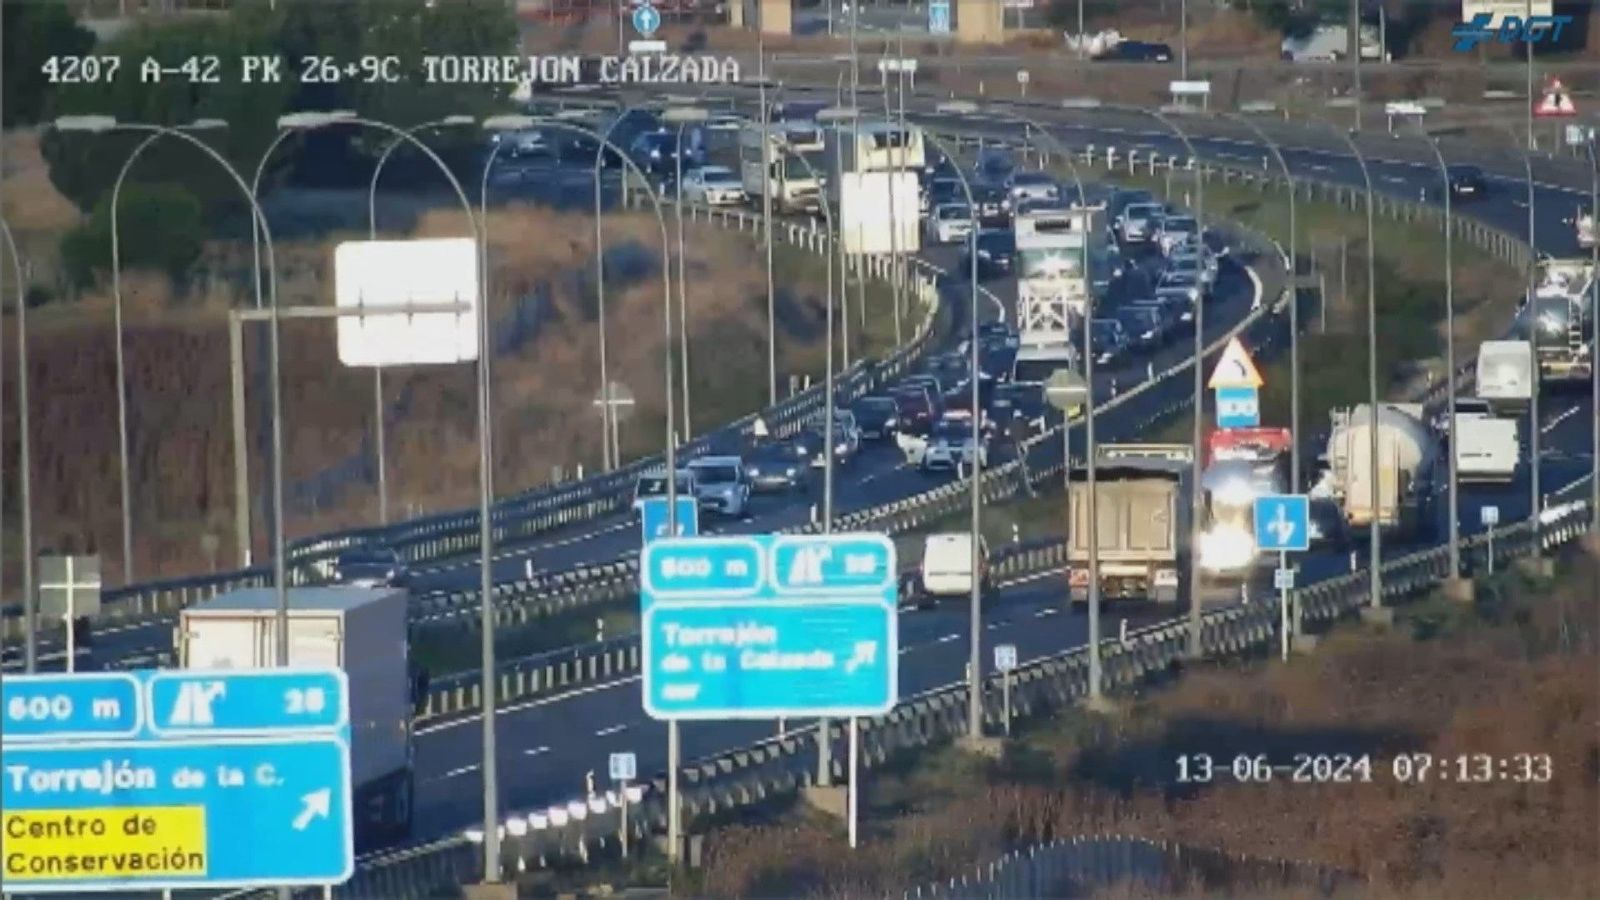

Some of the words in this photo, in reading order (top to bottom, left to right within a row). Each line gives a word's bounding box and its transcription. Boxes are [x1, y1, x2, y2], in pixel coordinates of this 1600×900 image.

[8, 695, 73, 721] 600
[92, 698, 121, 719] m
[6, 759, 157, 795] Torrejón
[172, 765, 206, 789] de
[217, 764, 245, 788] la
[255, 762, 285, 787] C.
[6, 815, 107, 839] Centro
[122, 813, 157, 837] de
[6, 846, 205, 874] Conservación
